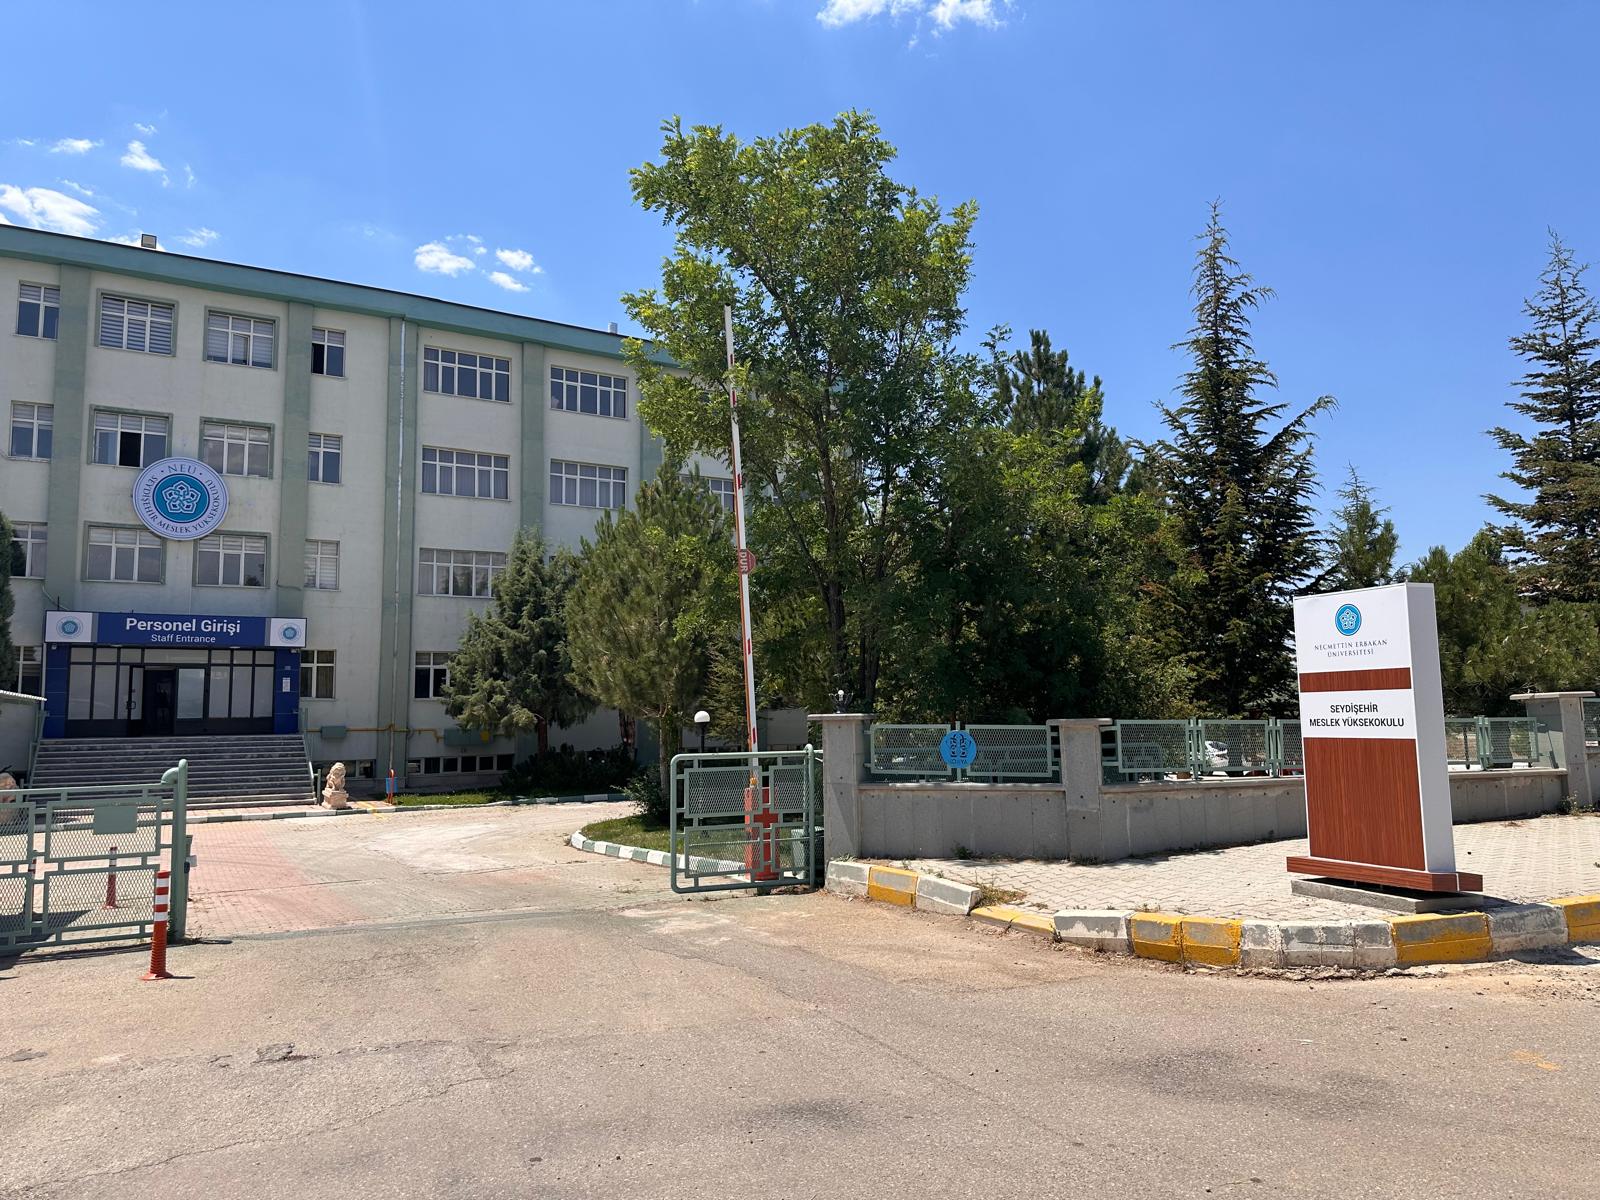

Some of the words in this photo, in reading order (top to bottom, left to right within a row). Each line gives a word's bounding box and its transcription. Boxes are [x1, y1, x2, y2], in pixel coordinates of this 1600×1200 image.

[157, 520, 191, 533] MESLEK
[126, 618, 196, 632] Personel
[200, 619, 241, 636] Girişi
[151, 633, 174, 643] Staff
[175, 634, 216, 644] Entrance
[1355, 639, 1388, 648] ERBAKAN
[1330, 702, 1379, 715] SEYDİŞEHİR
[1309, 718, 1341, 727] MESLEK
[1342, 717, 1405, 727] YÜKSEKOKULU
